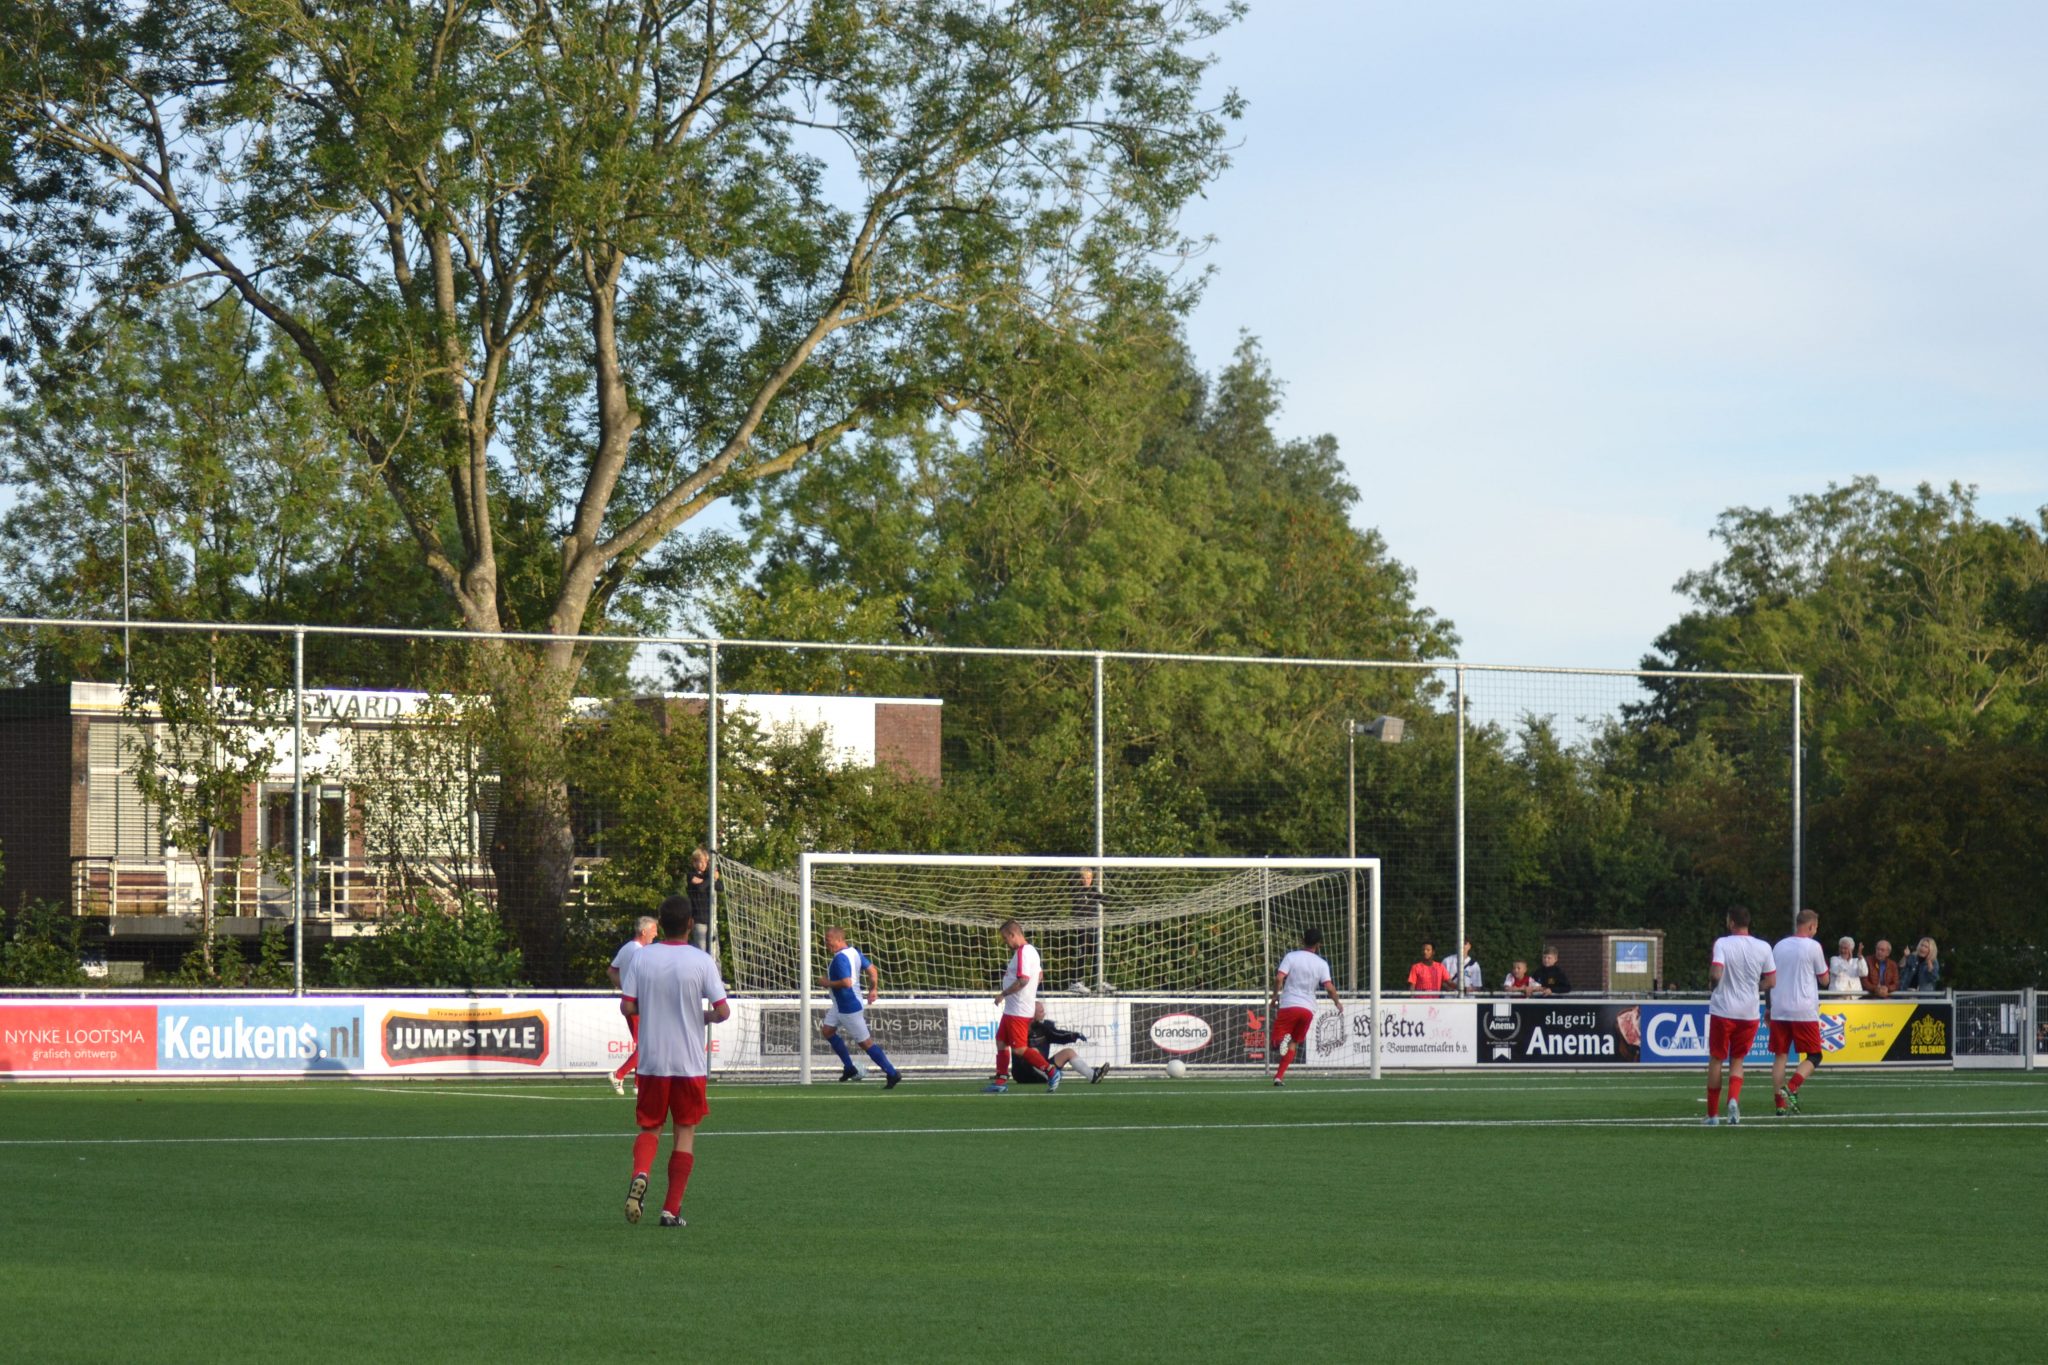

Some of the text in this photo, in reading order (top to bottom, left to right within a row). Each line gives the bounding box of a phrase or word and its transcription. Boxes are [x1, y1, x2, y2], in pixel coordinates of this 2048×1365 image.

[908, 1019, 943, 1031] DIRK
[1489, 1020, 1516, 1030] Anema
[1544, 1011, 1597, 1029] slagerij
[4, 1029, 145, 1044] NYNKE LOOTSMA
[164, 1015, 360, 1060] Keukens.nl
[393, 1026, 536, 1050] JUMPSTYLE
[1154, 1026, 1209, 1038] brandsma
[1525, 1026, 1616, 1056] Anema
[32, 1048, 117, 1061] grafisch ontwerp
[765, 1043, 794, 1055] DIRK
[1910, 1045, 1919, 1055] SC
